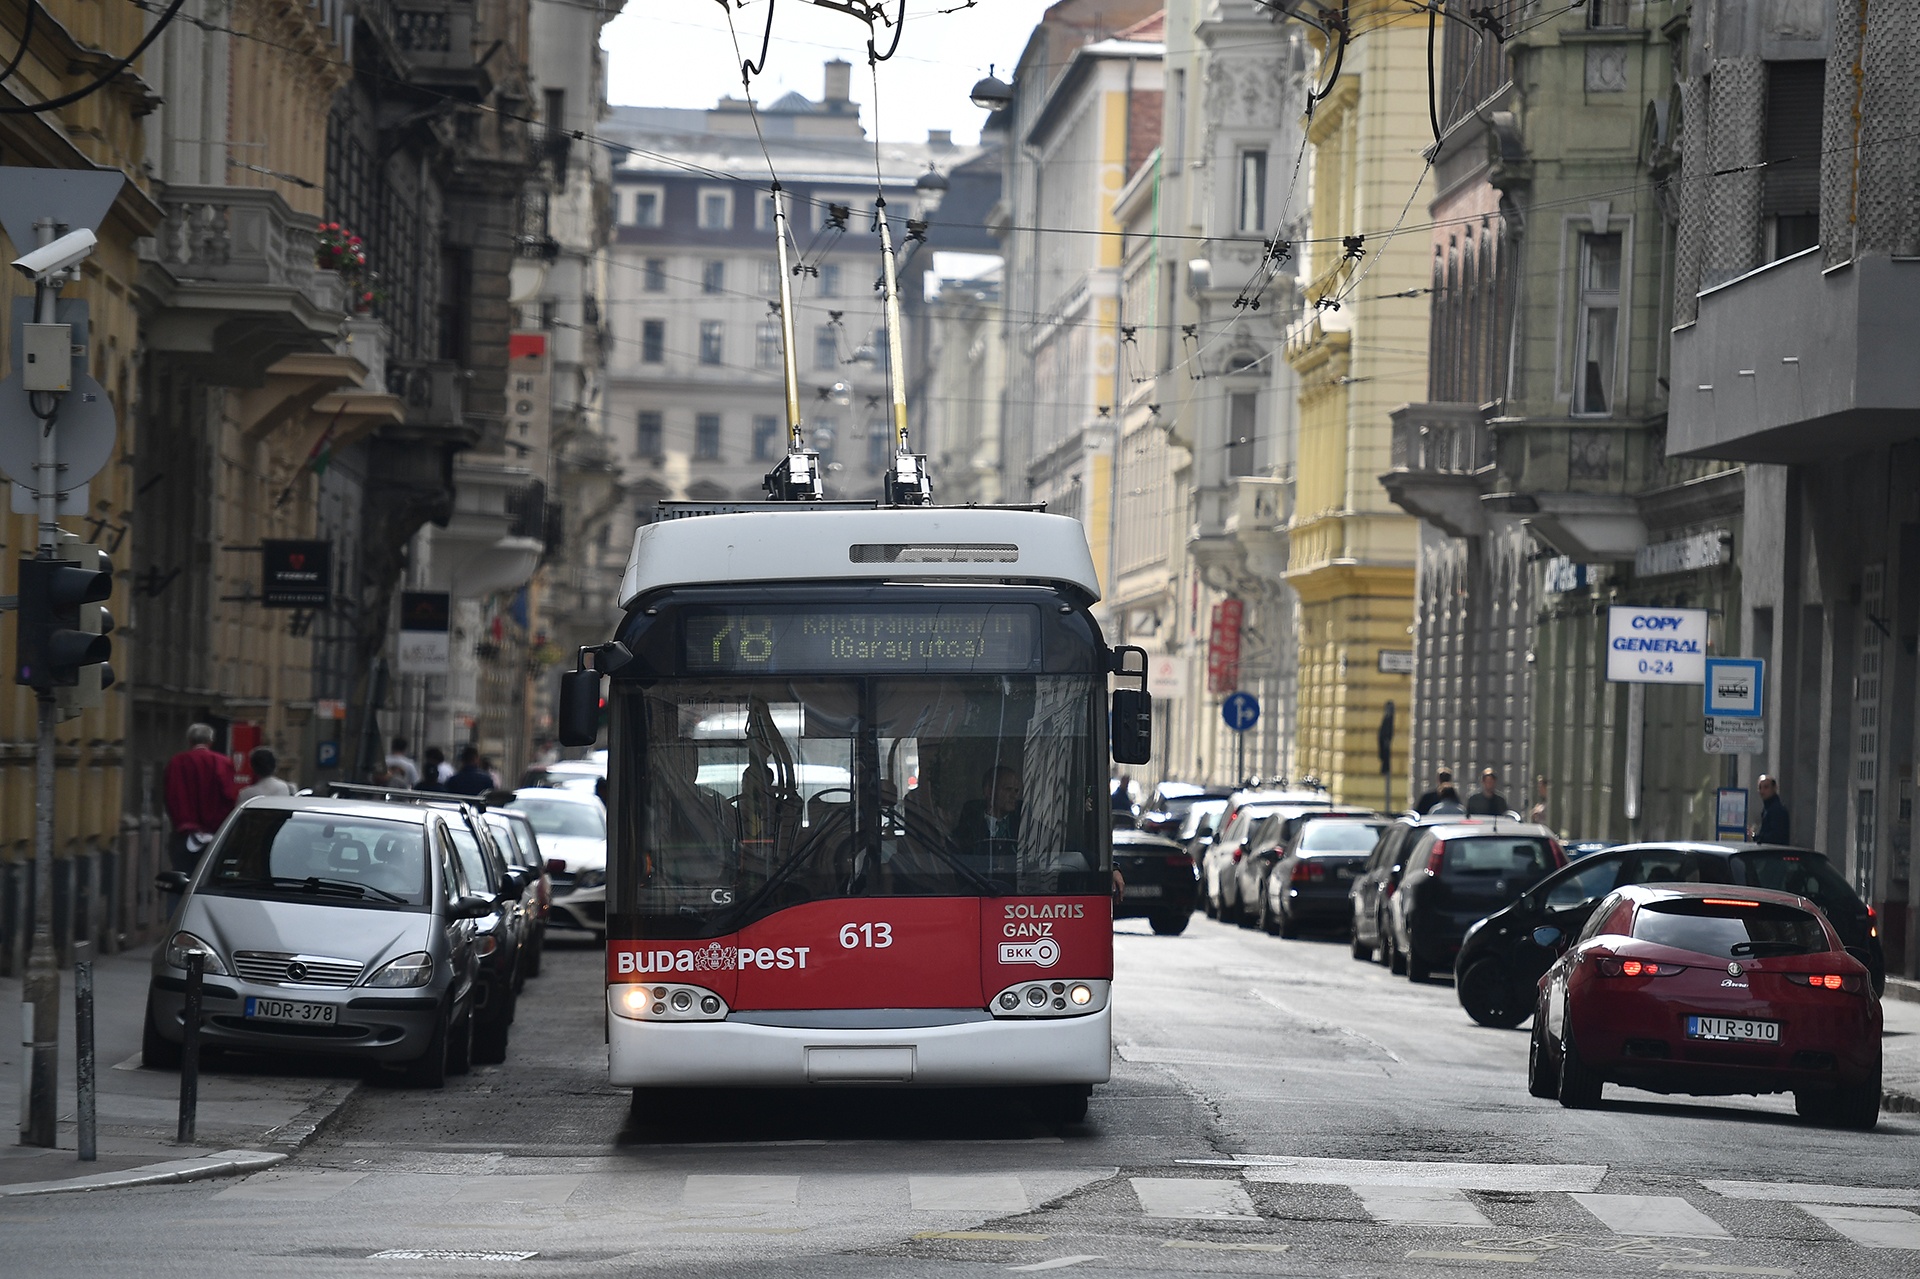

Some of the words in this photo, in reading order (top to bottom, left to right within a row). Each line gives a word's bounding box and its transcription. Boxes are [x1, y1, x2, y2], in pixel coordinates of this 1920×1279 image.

[1631, 615, 1684, 631] COPY
[704, 615, 773, 662] 78
[1613, 636, 1702, 654] GENERAL
[831, 636, 912, 660] (Garay
[919, 636, 985, 658] utca)
[1638, 659, 1674, 675] 0-24
[710, 888, 732, 904] Cs
[1004, 904, 1084, 919] SOLARIS
[839, 922, 893, 949] 613
[1003, 922, 1053, 937] GANZ
[1006, 948, 1033, 958] BKK
[257, 1001, 333, 1021] NDR-378
[1700, 1018, 1775, 1039] NIR-910
